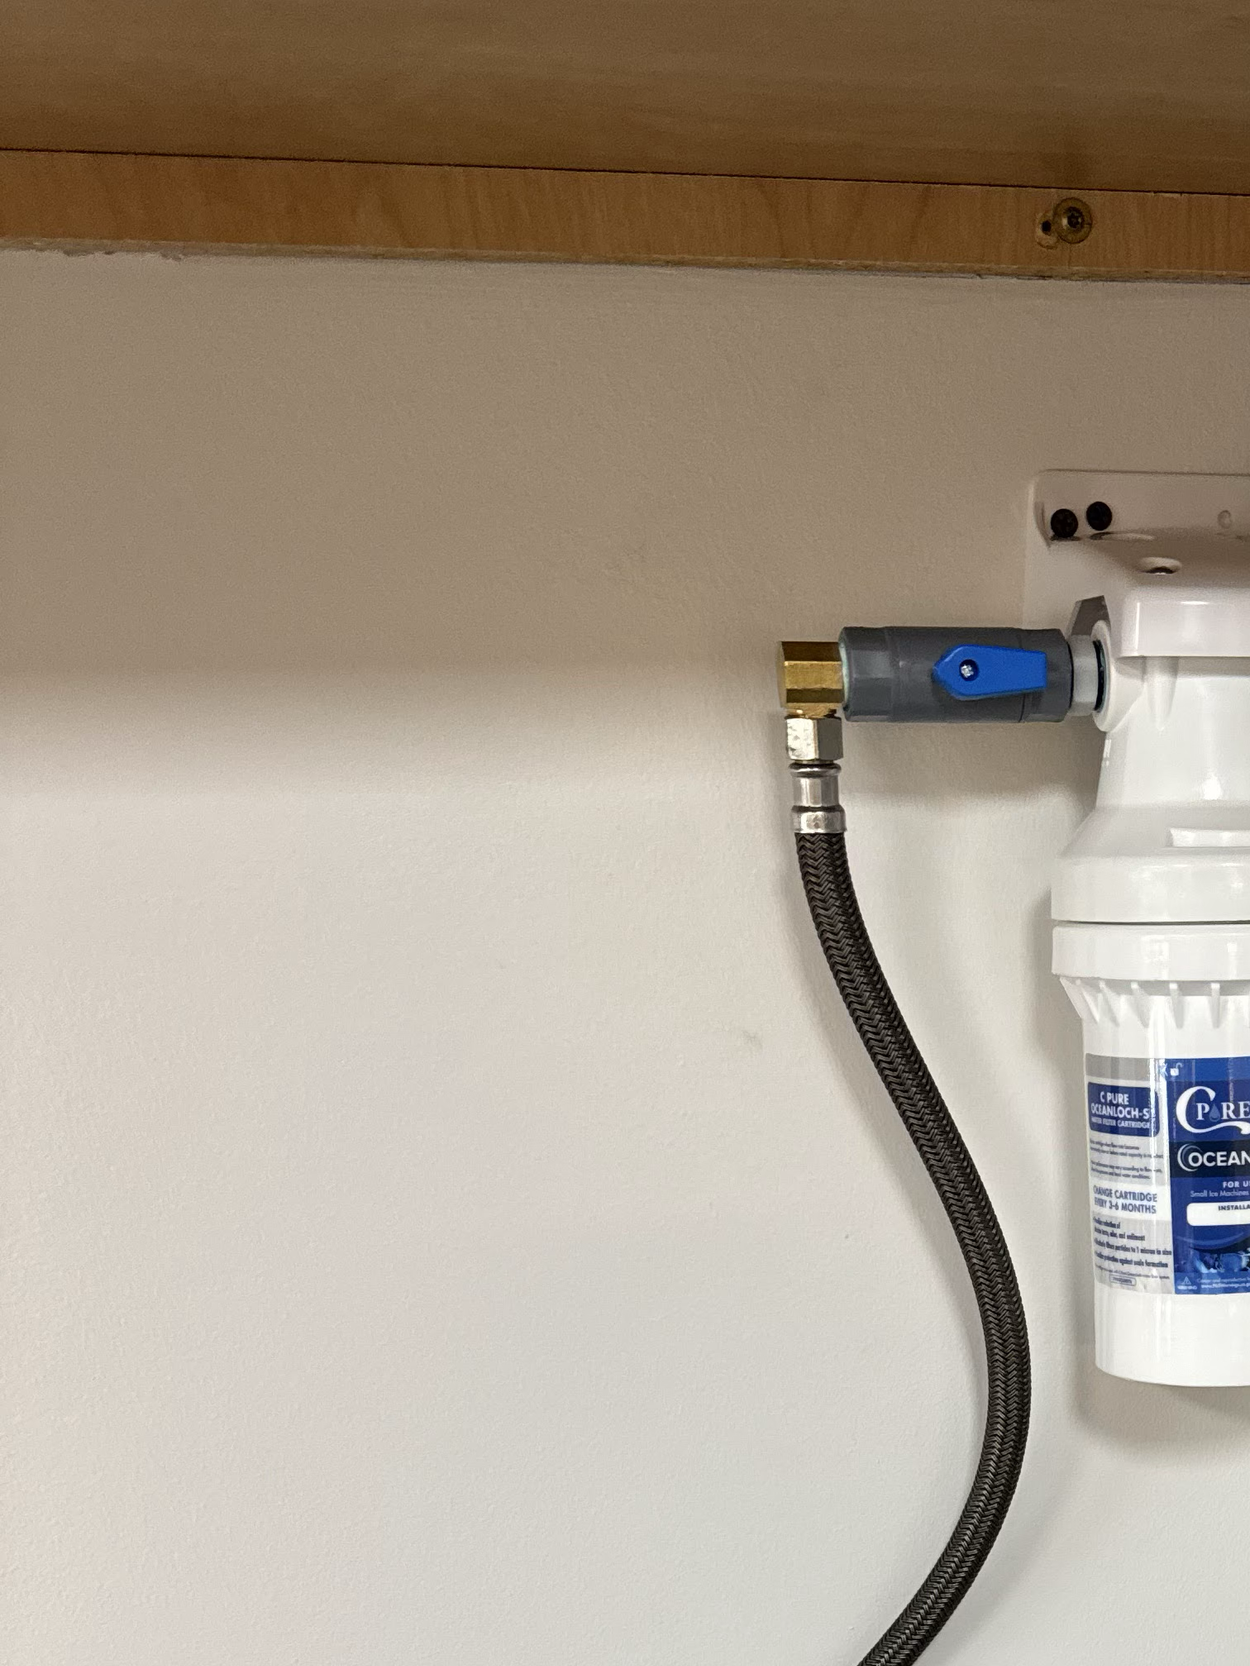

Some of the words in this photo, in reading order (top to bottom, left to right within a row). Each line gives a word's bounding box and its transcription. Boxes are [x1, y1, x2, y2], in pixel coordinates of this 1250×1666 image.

[1107, 1092, 1129, 1104] PURE
[1114, 1190, 1157, 1202] CARTRIDGE
[1108, 1200, 1119, 1210] 3-6
[1122, 1203, 1156, 1214] MONTHS
